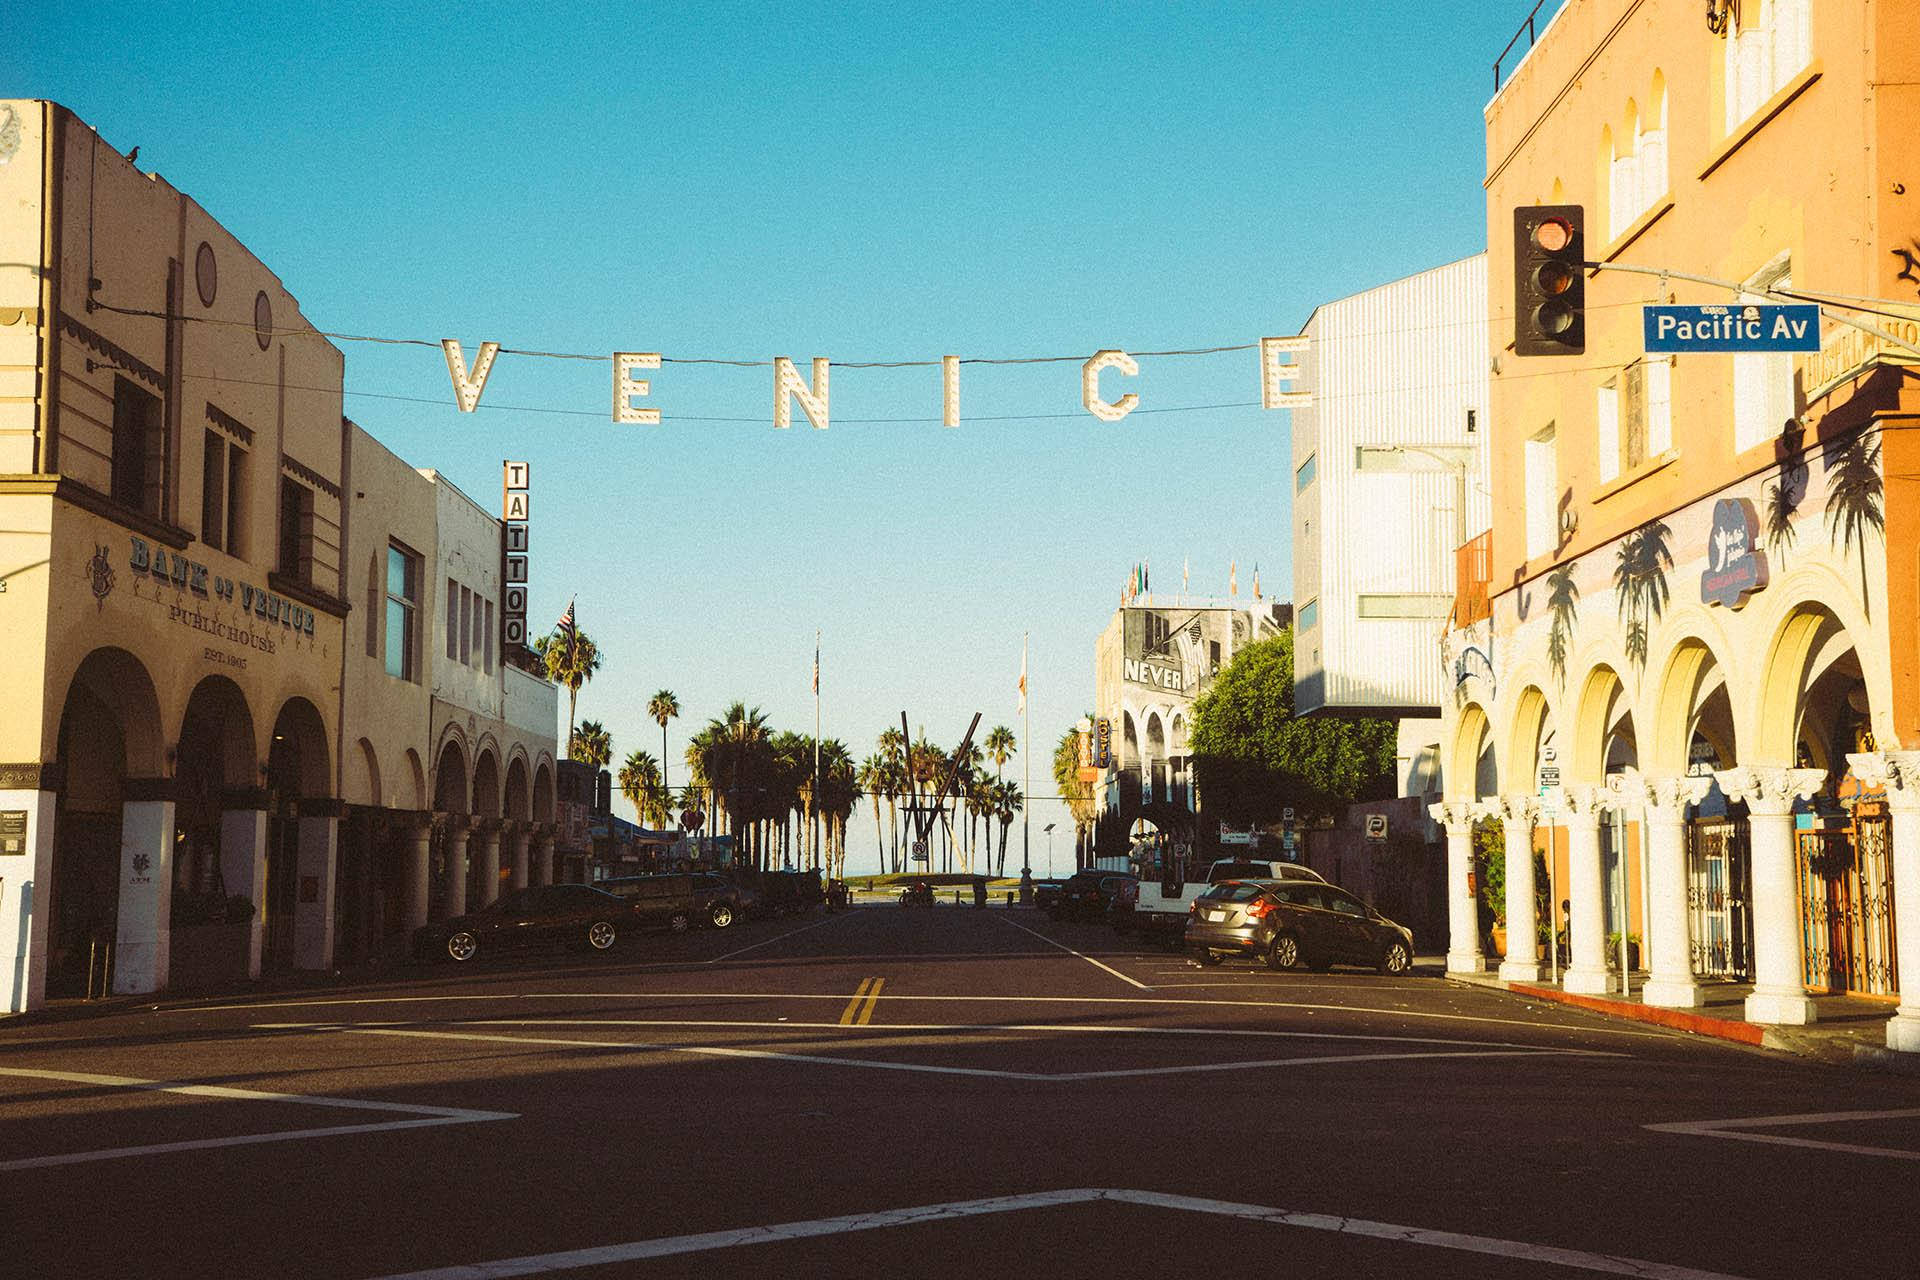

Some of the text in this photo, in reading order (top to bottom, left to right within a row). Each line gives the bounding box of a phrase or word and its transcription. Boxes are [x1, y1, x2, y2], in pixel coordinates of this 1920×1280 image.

[1657, 314, 1808, 340] Pacific Av
[441, 335, 1313, 428] VENICE
[130, 536, 209, 597] BANK
[239, 580, 315, 636] VENICE
[507, 466, 524, 641] TATTOO
[1123, 657, 1182, 691] NEVER
